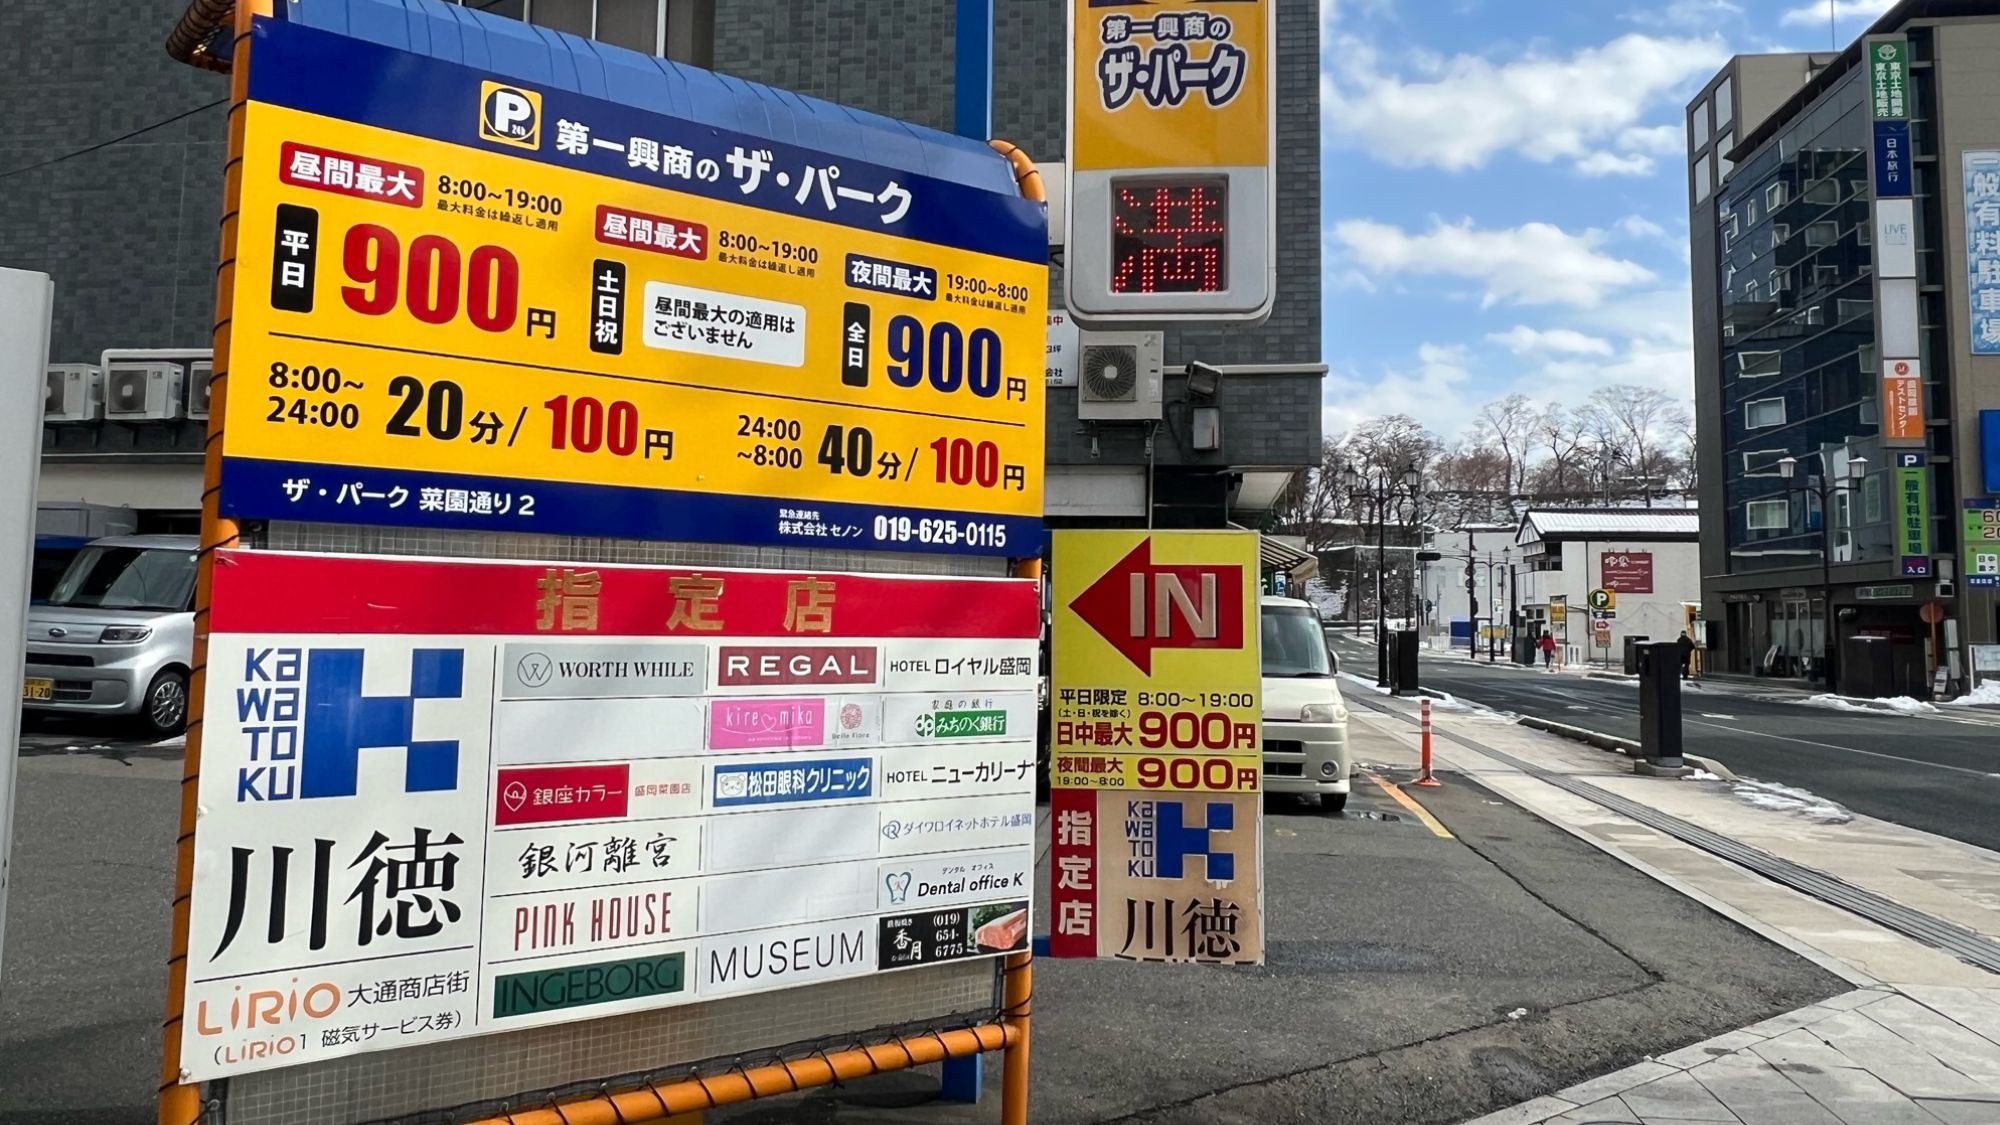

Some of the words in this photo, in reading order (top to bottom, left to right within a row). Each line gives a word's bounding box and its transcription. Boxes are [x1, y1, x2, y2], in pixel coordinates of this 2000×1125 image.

[1105, 17, 1227, 41] 第一興商の
[1104, 48, 1241, 103] ザ・パーク
[495, 91, 531, 132] P
[289, 150, 417, 202] 昼間最大
[1886, 138, 1899, 183] 日本旅行
[437, 199, 559, 232] 最大料金は繰返し適用
[603, 213, 702, 254] 昼間最大
[281, 229, 310, 289] 平日
[851, 260, 932, 295] 夜間最大
[594, 269, 620, 345] 土日祝
[654, 296, 795, 334] 昼間最大の適用は
[653, 320, 753, 349] ございません
[847, 321, 866, 369] 全日
[266, 395, 360, 430] 24:00
[737, 414, 802, 442] 24:00
[282, 478, 410, 509] ザ・パーク
[419, 486, 536, 518] 菜園通り2
[779, 508, 820, 522] 緊急連絡先
[874, 514, 1007, 548] 019-625-0115
[1129, 572, 1217, 638] IN
[558, 661, 628, 678] WORTH
[633, 661, 694, 678] WHILE
[727, 654, 869, 677] REGAL
[890, 660, 931, 673] HOTEL
[934, 656, 1032, 677] ロイヤル盛岡
[1059, 688, 1127, 706] 平日限定
[936, 715, 1006, 734] みちのく銀行
[1057, 721, 1133, 747] 日中最大
[747, 766, 870, 797] 松田眼科クリニック
[886, 770, 928, 783] HOTEL
[931, 760, 1034, 785] ニューカリーナ
[1057, 757, 1124, 774] 夜間最大
[532, 784, 623, 806] 銀座カラー
[903, 813, 1032, 836] ダイワロイネットホテル盛岡
[517, 832, 678, 880] 銀河離宮
[1057, 809, 1093, 937] 指定店
[209, 826, 465, 963] 川徳
[917, 877, 966, 897] Dental
[969, 874, 1009, 892] office
[1013, 872, 1025, 887] K
[514, 902, 575, 951] PINK
[590, 891, 672, 943] HOUSE
[933, 911, 961, 927] (019)
[1121, 897, 1241, 958] 川徳
[709, 930, 864, 985] MUSEUM
[935, 943, 963, 958] 6775
[347, 969, 471, 1008] 大通商店街
[501, 957, 678, 1012] INGEBORG
